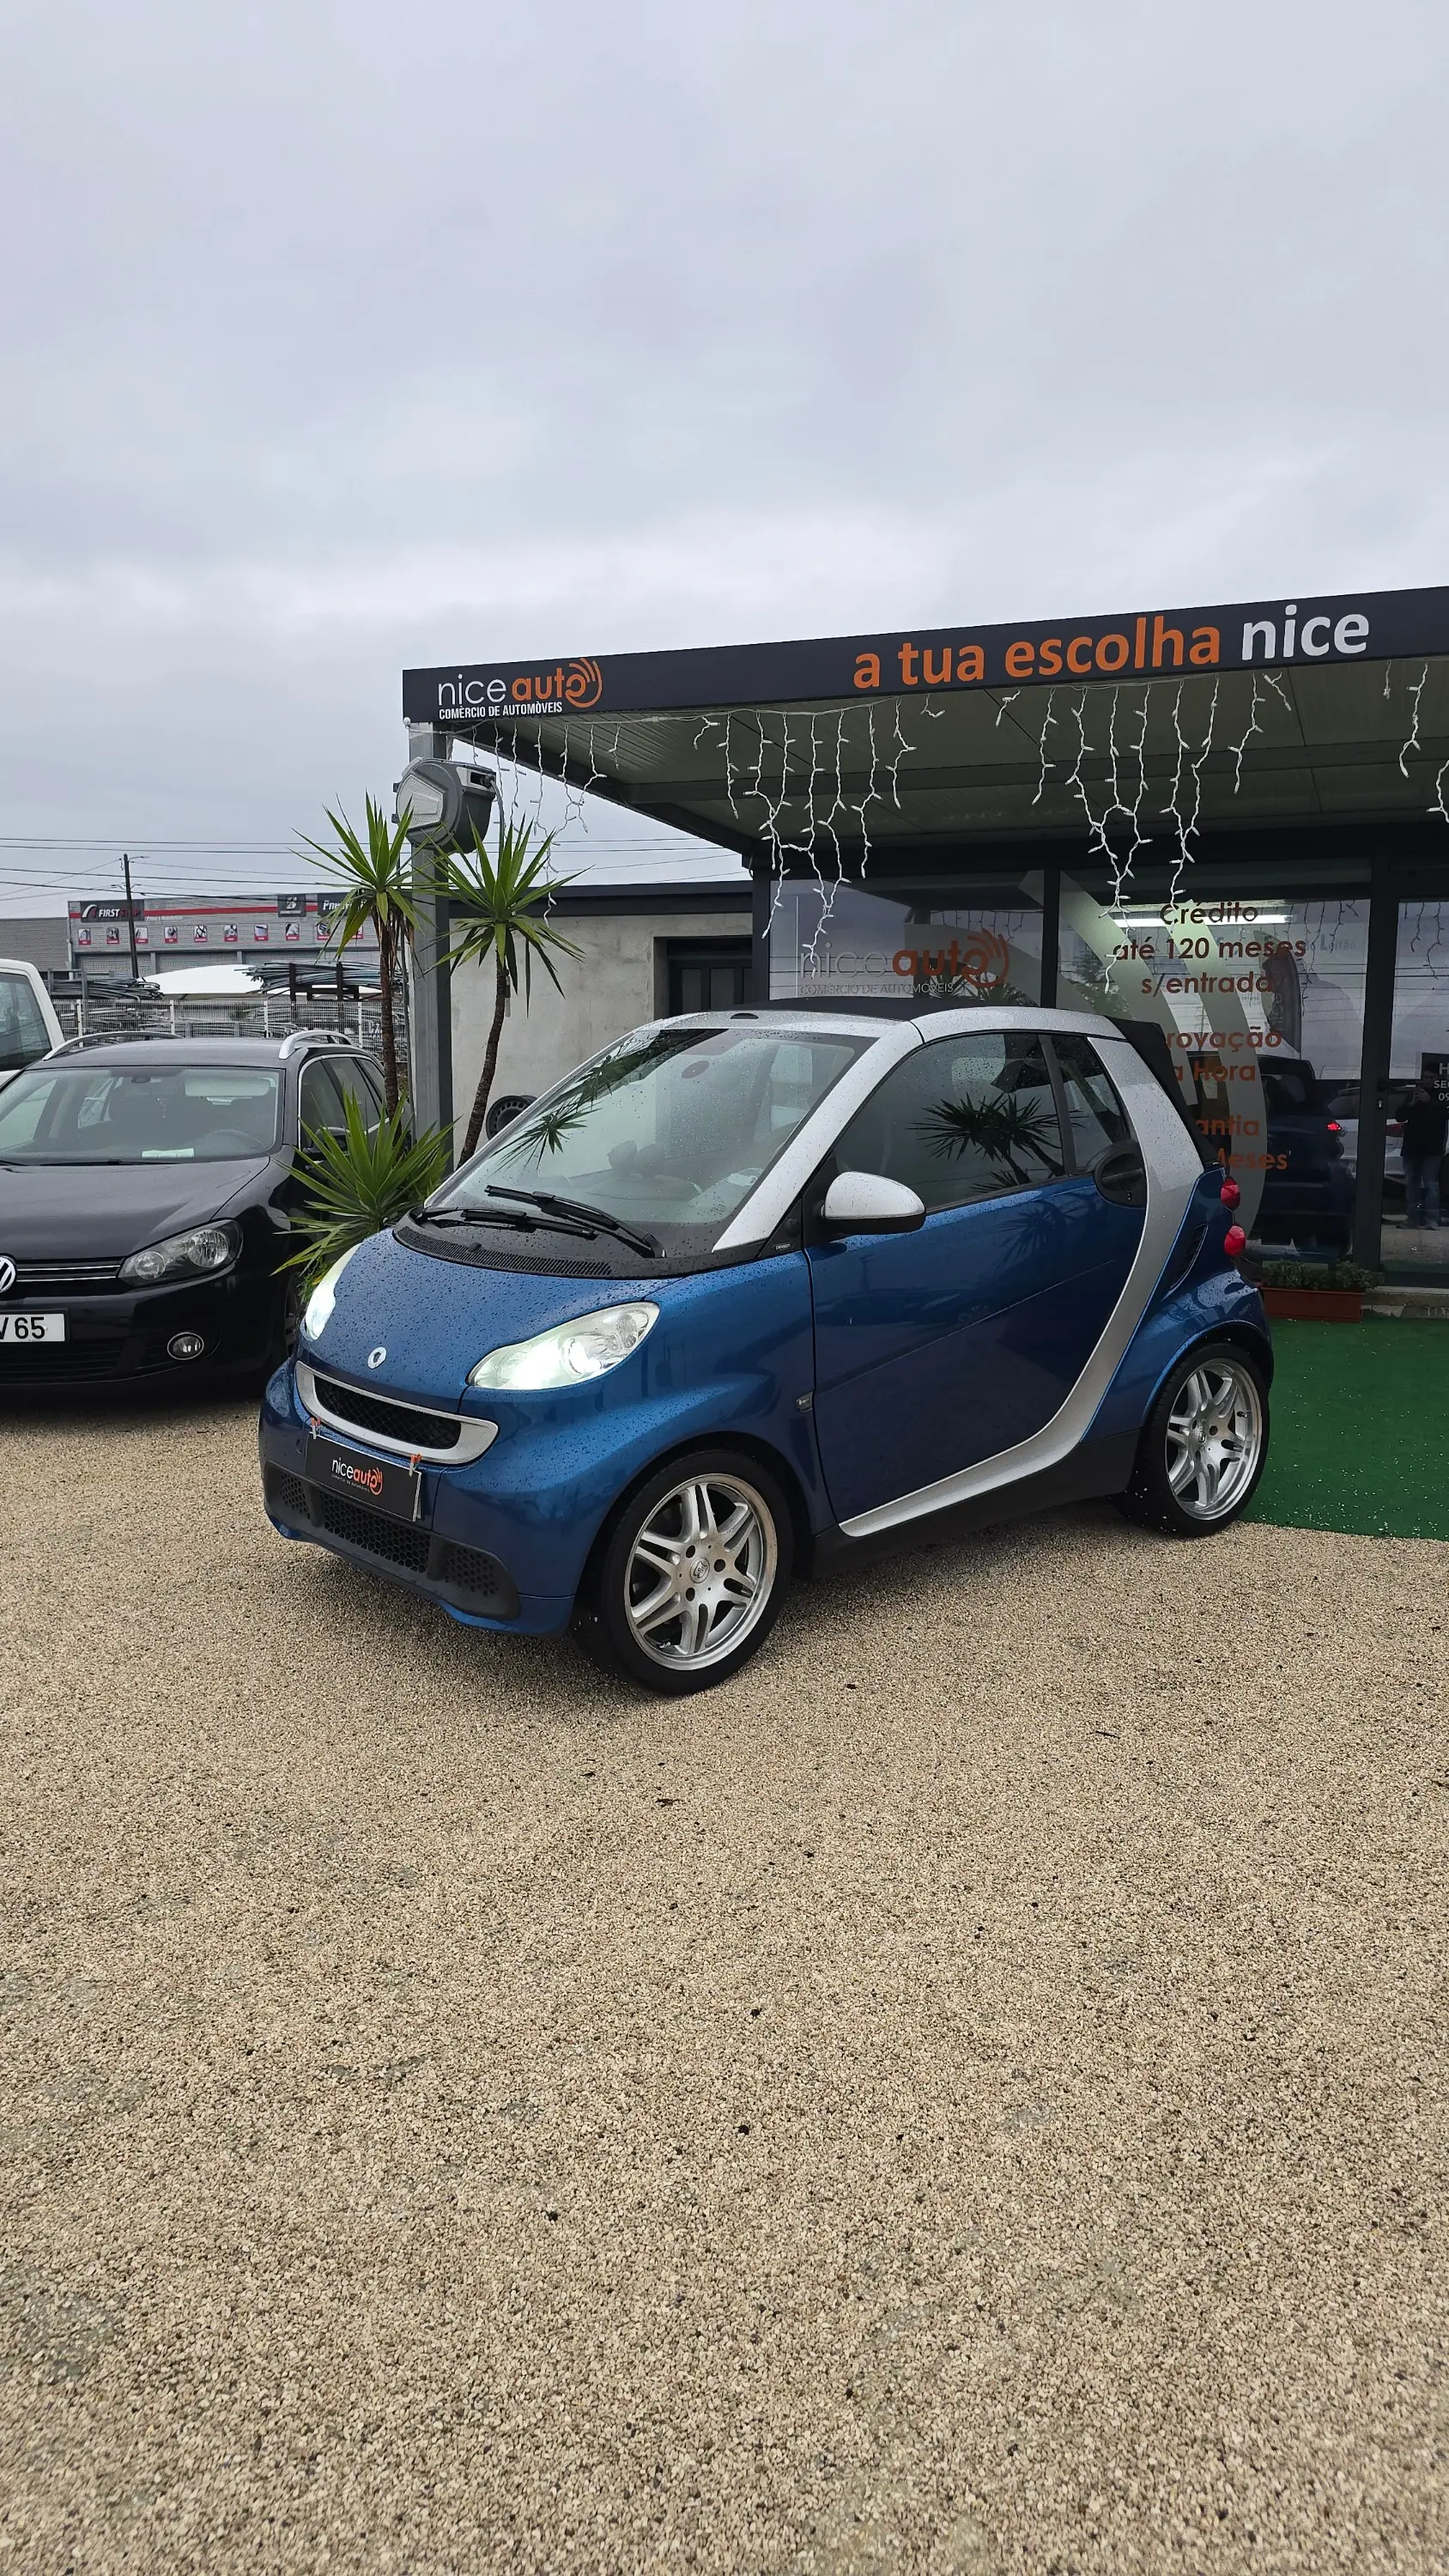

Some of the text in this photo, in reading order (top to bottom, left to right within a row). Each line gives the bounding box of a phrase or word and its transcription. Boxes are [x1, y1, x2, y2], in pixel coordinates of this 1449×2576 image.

[853, 605, 1369, 689] a tua escolha nice
[488, 705, 500, 717] DE
[99, 908, 119, 918] FIRST
[1161, 902, 1258, 925] Crédito
[1113, 936, 1155, 960] até
[1166, 938, 1210, 959] 120
[1218, 940, 1306, 958] meses
[861, 983, 878, 994] DE
[1141, 970, 1273, 997] s/entrada
[1194, 1060, 1256, 1082] Hora
[15, 1316, 45, 1340] 65
